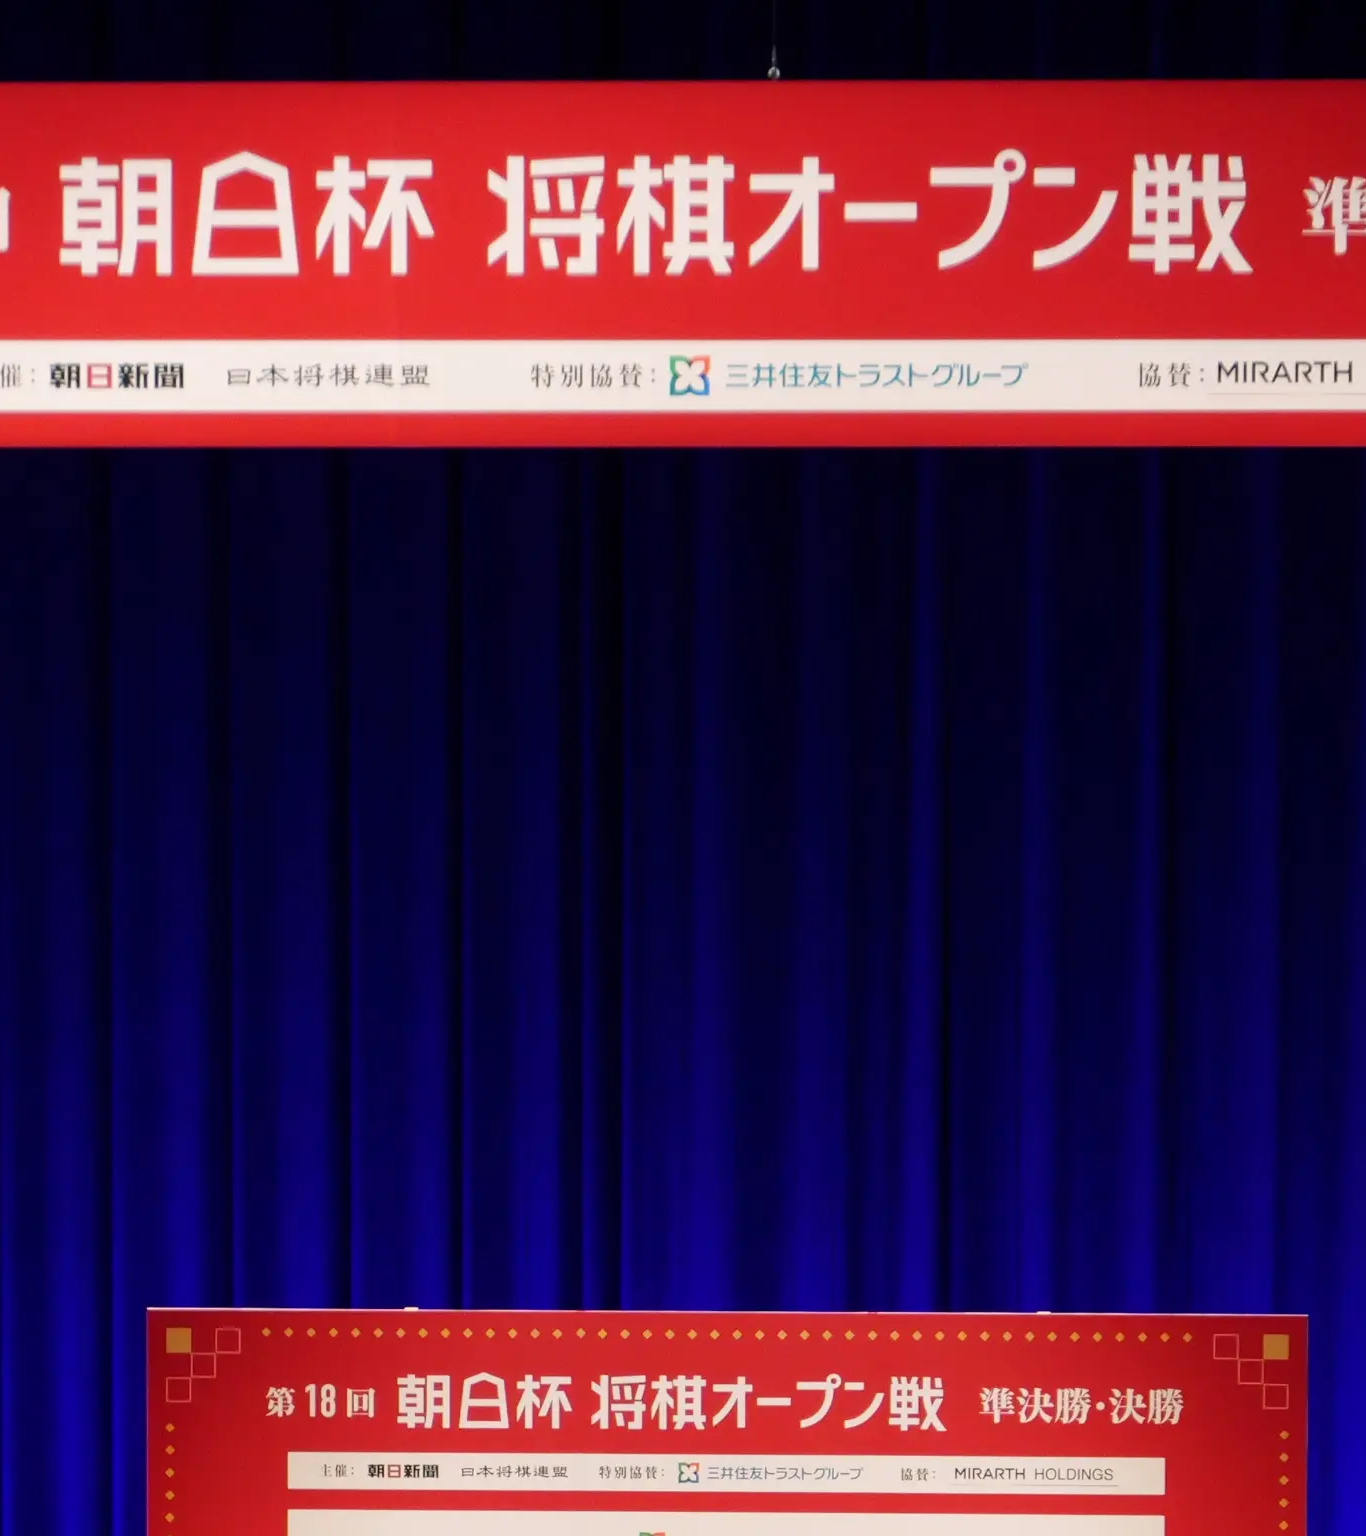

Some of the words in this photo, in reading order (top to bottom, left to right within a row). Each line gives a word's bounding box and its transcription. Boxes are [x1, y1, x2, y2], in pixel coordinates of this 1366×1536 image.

[487, 150, 1253, 276] 将棋オープン戦
[51, 364, 183, 388] 朝日新聞
[227, 364, 429, 387] 日本将棋連盟
[727, 363, 1028, 387] 三井住友トラストグループ
[1218, 362, 1352, 383] MIRARTH
[591, 1374, 947, 1432] 将棋オープン戦
[979, 1388, 1184, 1424] 準決勝・決勝
[368, 1464, 438, 1478] 朝日新聞
[461, 1465, 568, 1478] 日本将棋連盟
[707, 1467, 863, 1480] 三井住友トラストグループ
[955, 1468, 1025, 1479] MIRARTH
[1035, 1468, 1113, 1480] HOLDINGS
